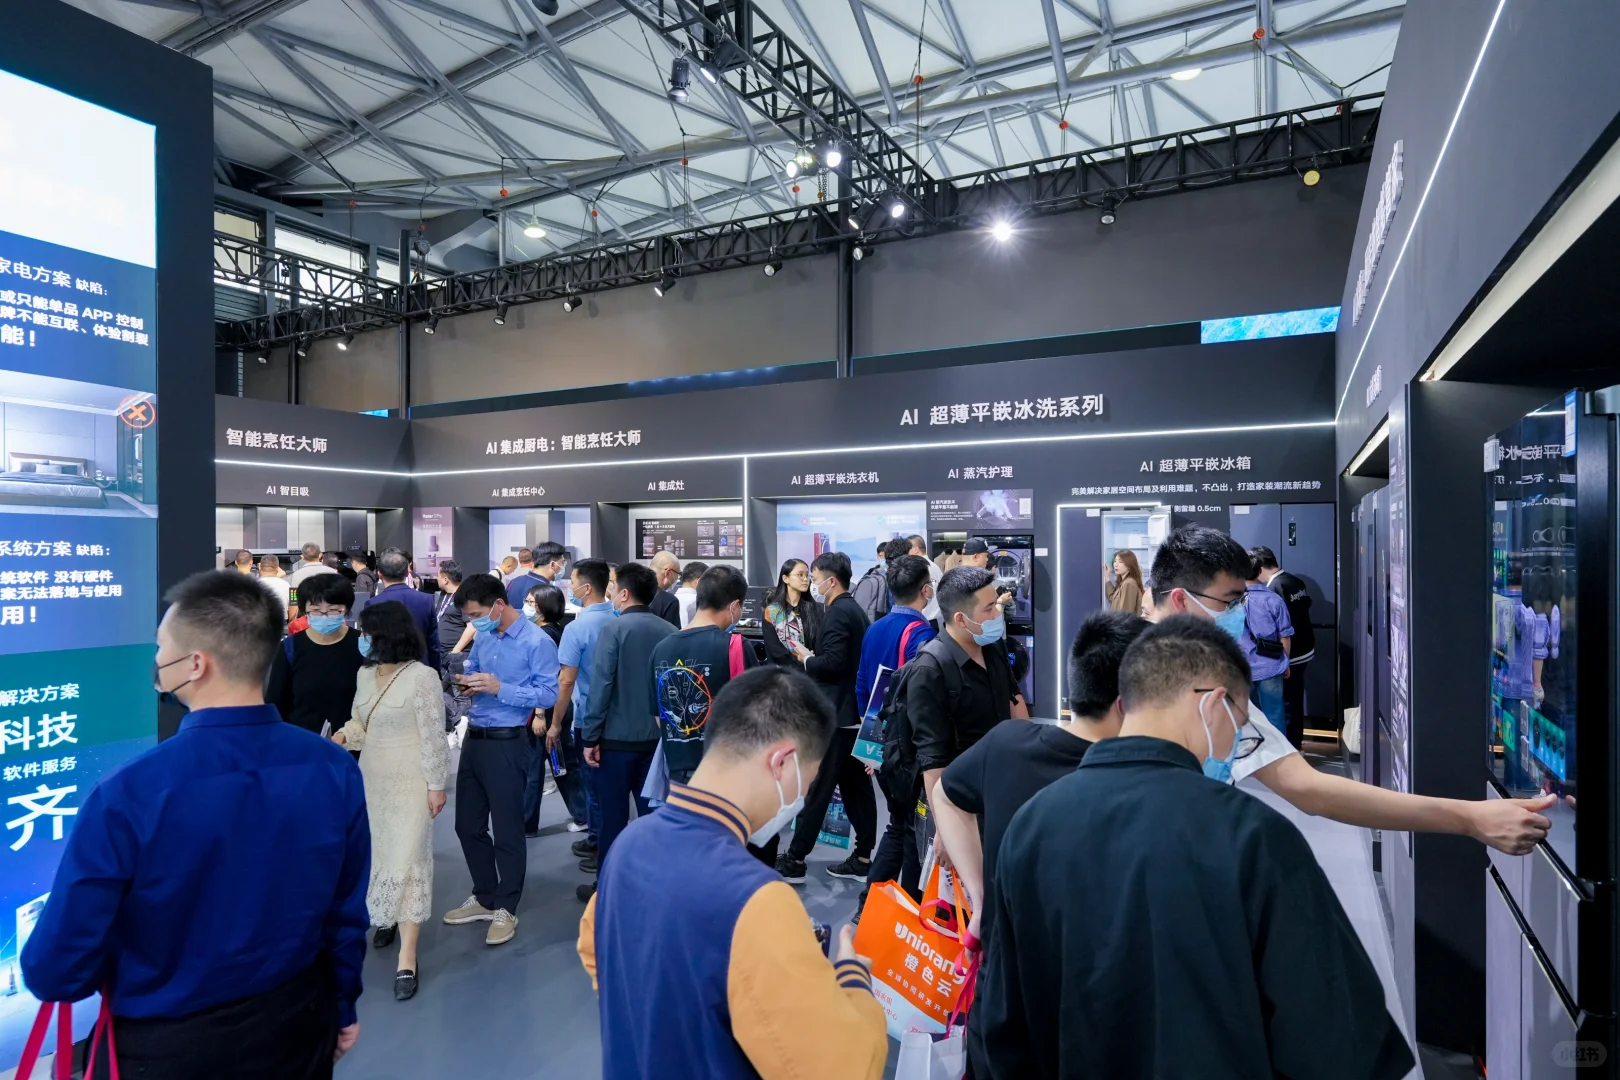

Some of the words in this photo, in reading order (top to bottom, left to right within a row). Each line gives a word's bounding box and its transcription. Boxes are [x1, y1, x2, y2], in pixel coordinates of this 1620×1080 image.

[0, 257, 72, 288] 家电方案
[0, 290, 79, 316] 或只能单品
[82, 307, 113, 322] APP
[116, 312, 144, 331] 控制
[900, 409, 919, 426] AI
[929, 393, 1105, 426] 超薄平嵌冰洗系列
[226, 428, 328, 453] 智能烹饪大师
[486, 442, 498, 455] AI
[1140, 460, 1154, 472] AI
[1159, 456, 1252, 473] 超薄平嵌冰箱
[791, 475, 801, 485] AI
[804, 472, 880, 486] 超薄平嵌洗衣机
[948, 468, 959, 479] AI
[963, 466, 1014, 480] 蒸汽护理
[266, 486, 276, 495] AI
[492, 488, 500, 497] AI
[648, 482, 656, 491] AI
[658, 480, 684, 492] 集成灶
[0, 540, 72, 556] 系统方案
[0, 570, 49, 584] 统软件
[54, 570, 114, 583] 没有硬件
[0, 584, 122, 600] 案无法落地与使用
[0, 683, 80, 707] 解决方案
[0, 711, 78, 754] 科技
[2, 756, 78, 781] 软件服务
[904, 952, 952, 998] 橙色云
